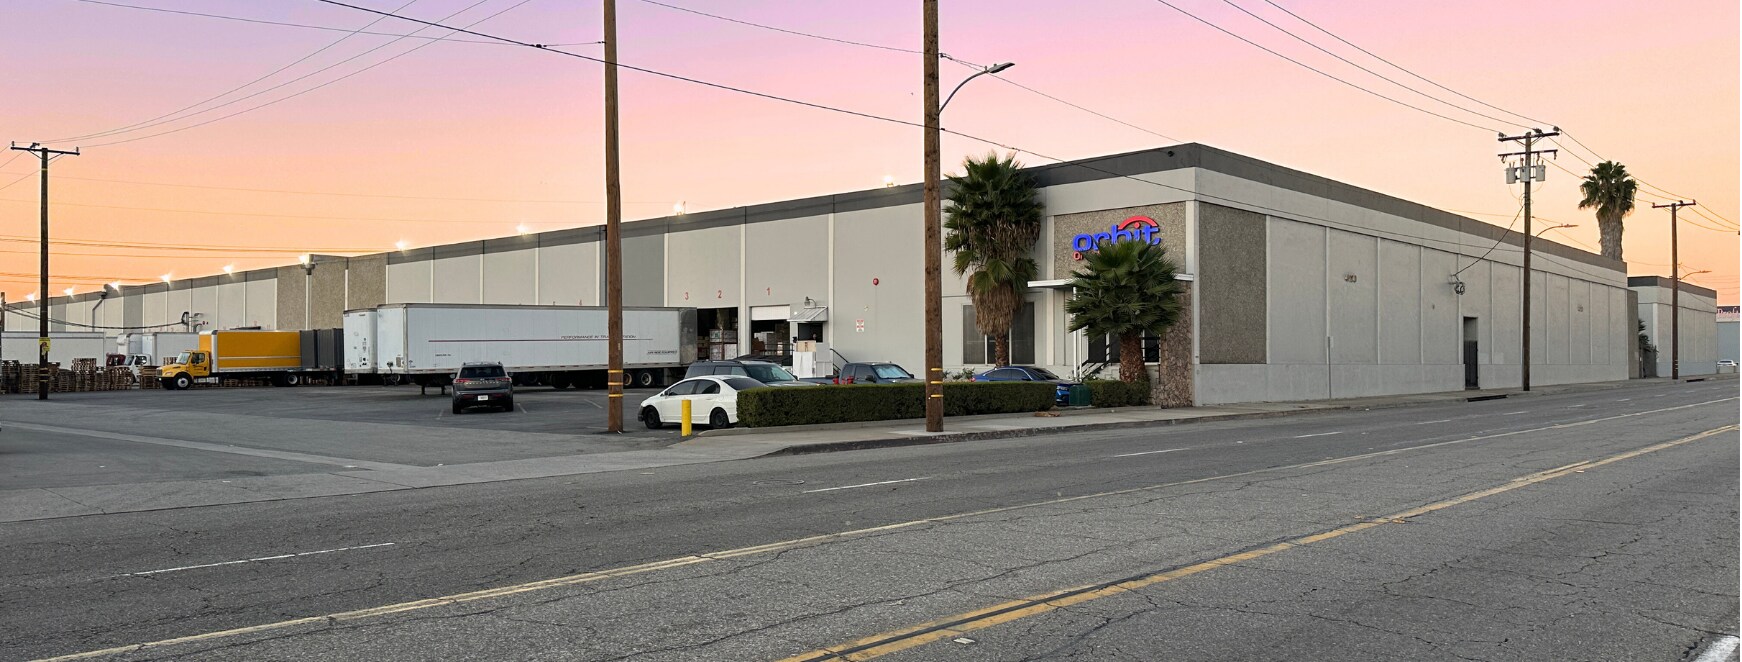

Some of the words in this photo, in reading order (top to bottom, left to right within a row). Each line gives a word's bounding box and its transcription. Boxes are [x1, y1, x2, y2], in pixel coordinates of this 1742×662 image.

[1072, 220, 1161, 252] orbit
[685, 292, 689, 300] 3
[718, 290, 722, 299] 2
[766, 287, 770, 296] 1
